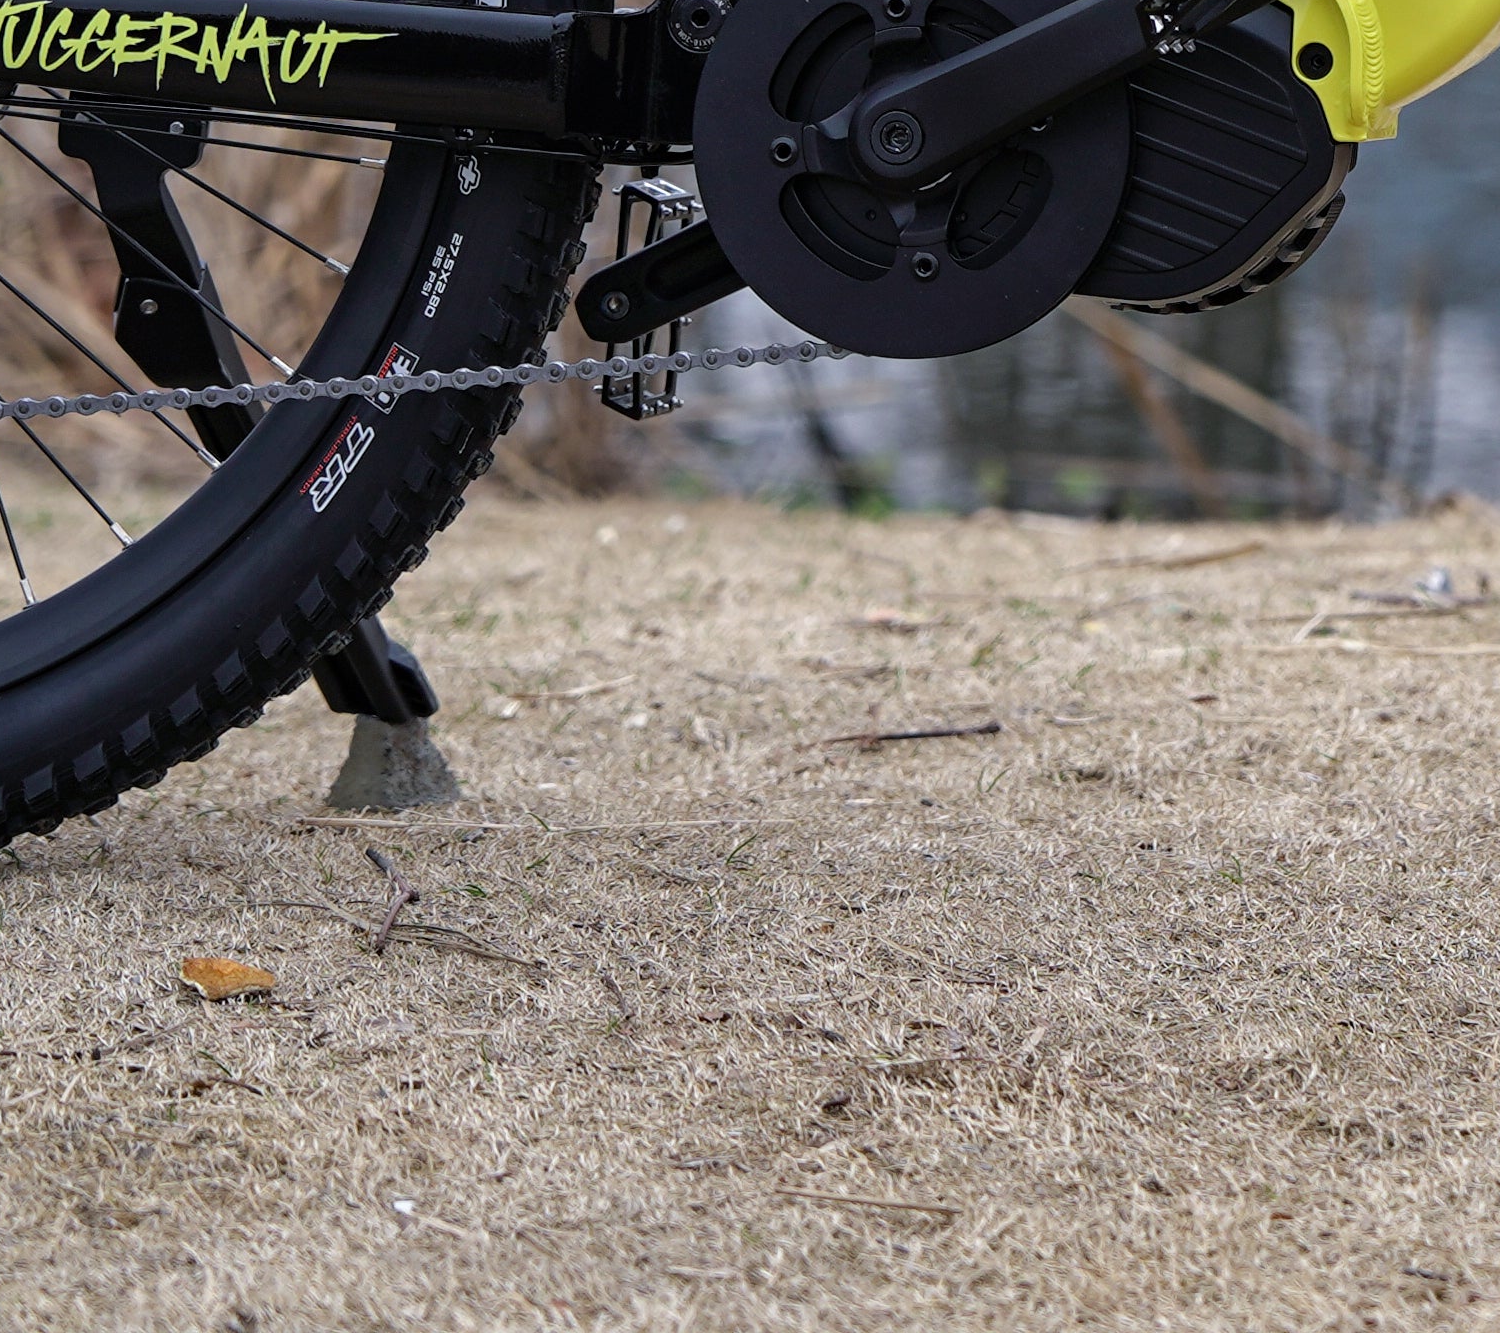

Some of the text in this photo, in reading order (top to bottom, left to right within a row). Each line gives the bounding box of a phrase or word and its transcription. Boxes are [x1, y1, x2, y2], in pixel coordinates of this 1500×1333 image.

[420, 244, 447, 297] 35 PSI
[424, 233, 464, 318] 27.5X2.80
[308, 422, 376, 513] TR
